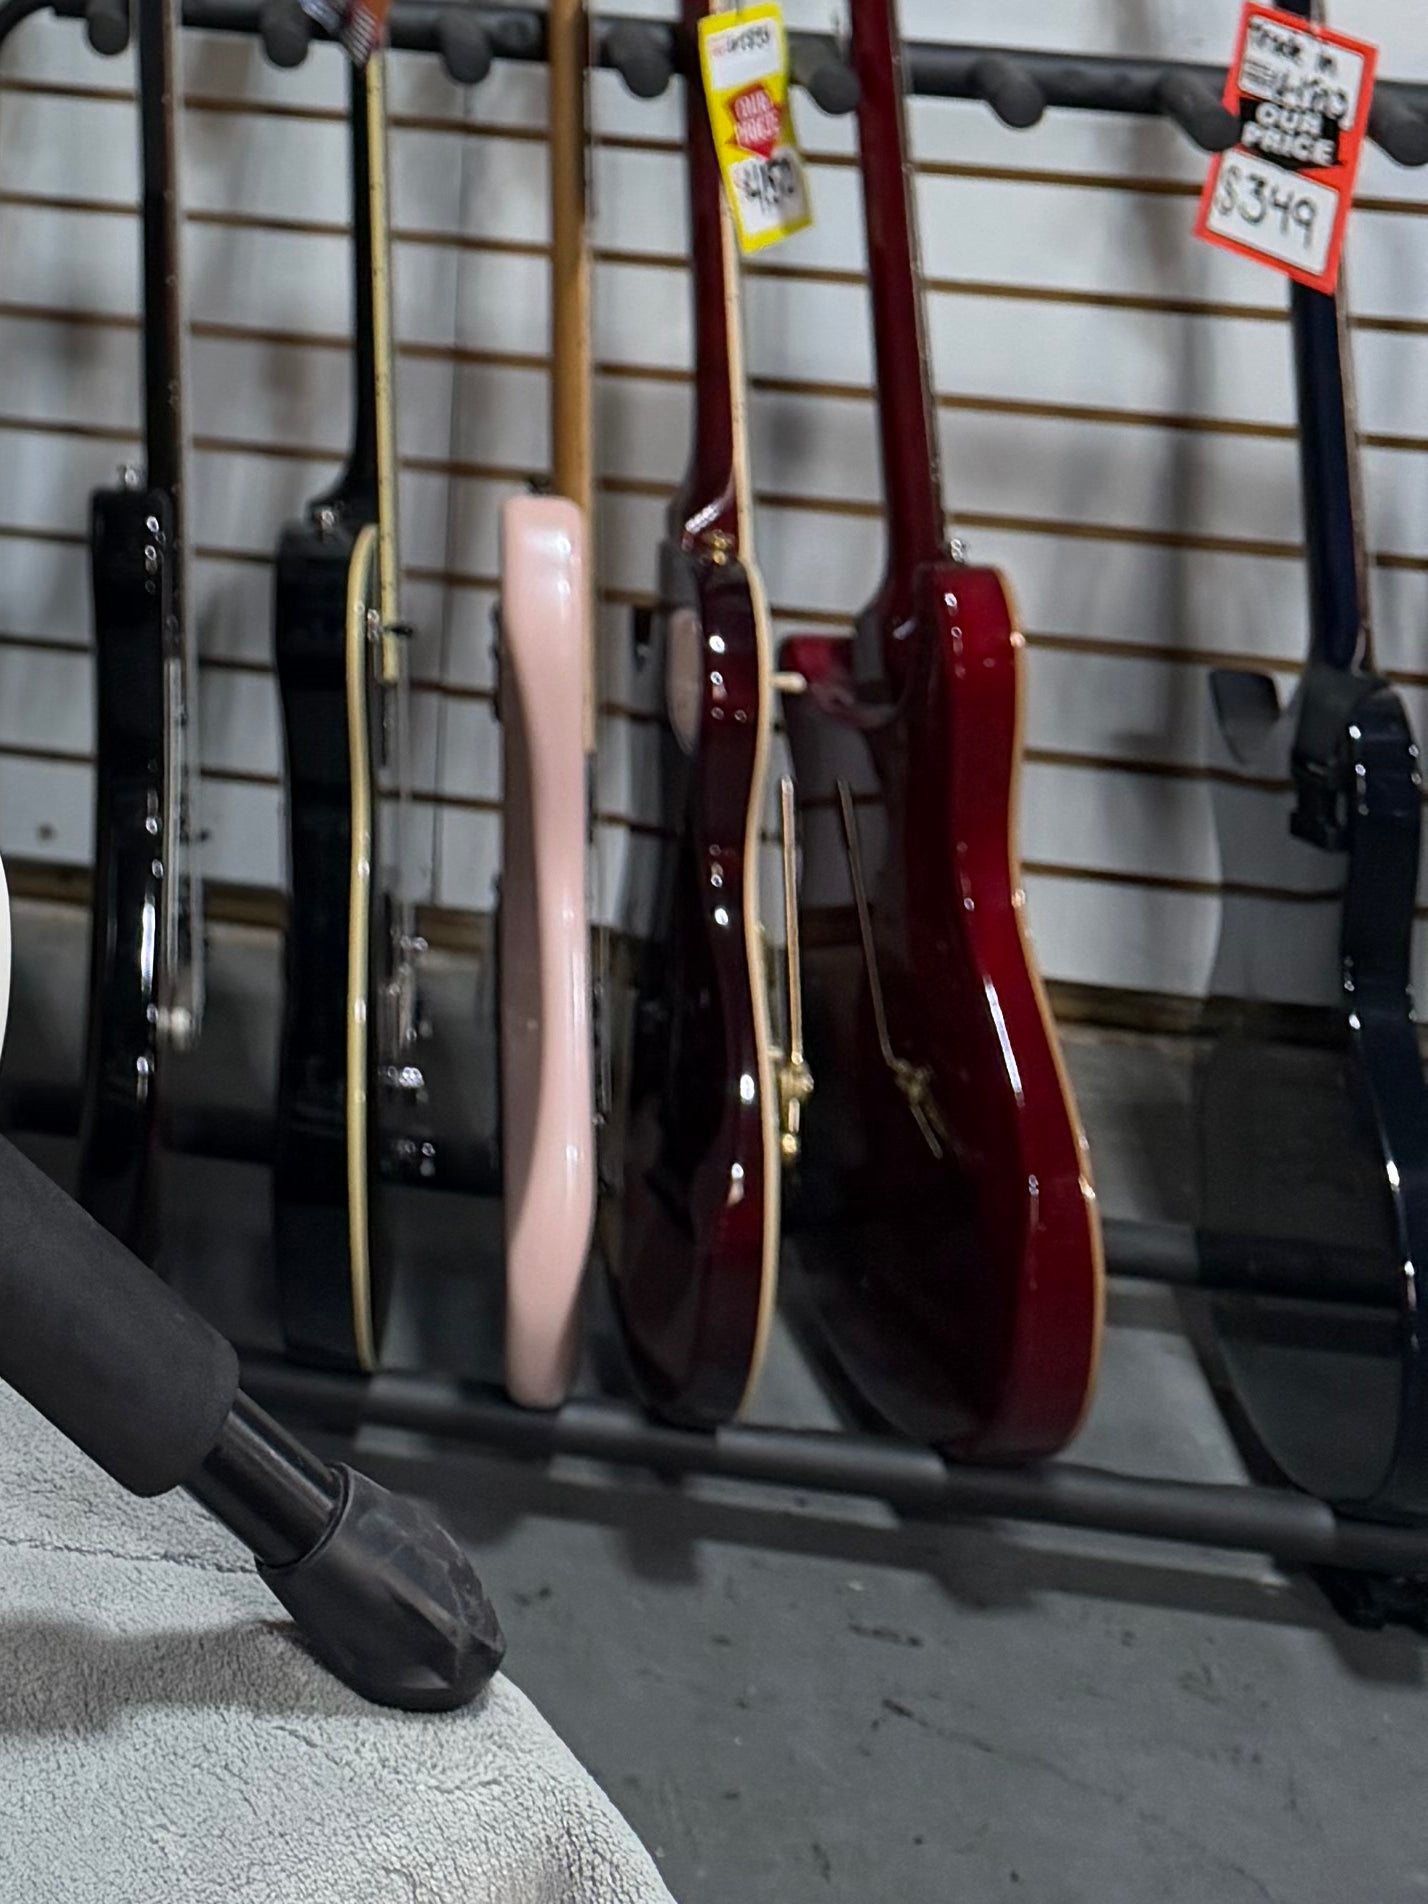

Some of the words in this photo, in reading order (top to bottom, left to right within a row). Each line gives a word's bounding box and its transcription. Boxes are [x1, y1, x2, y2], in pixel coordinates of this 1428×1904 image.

[1255, 102, 1323, 137] OUR
[1241, 120, 1337, 167] PRICE
[1214, 164, 1318, 249] $349
